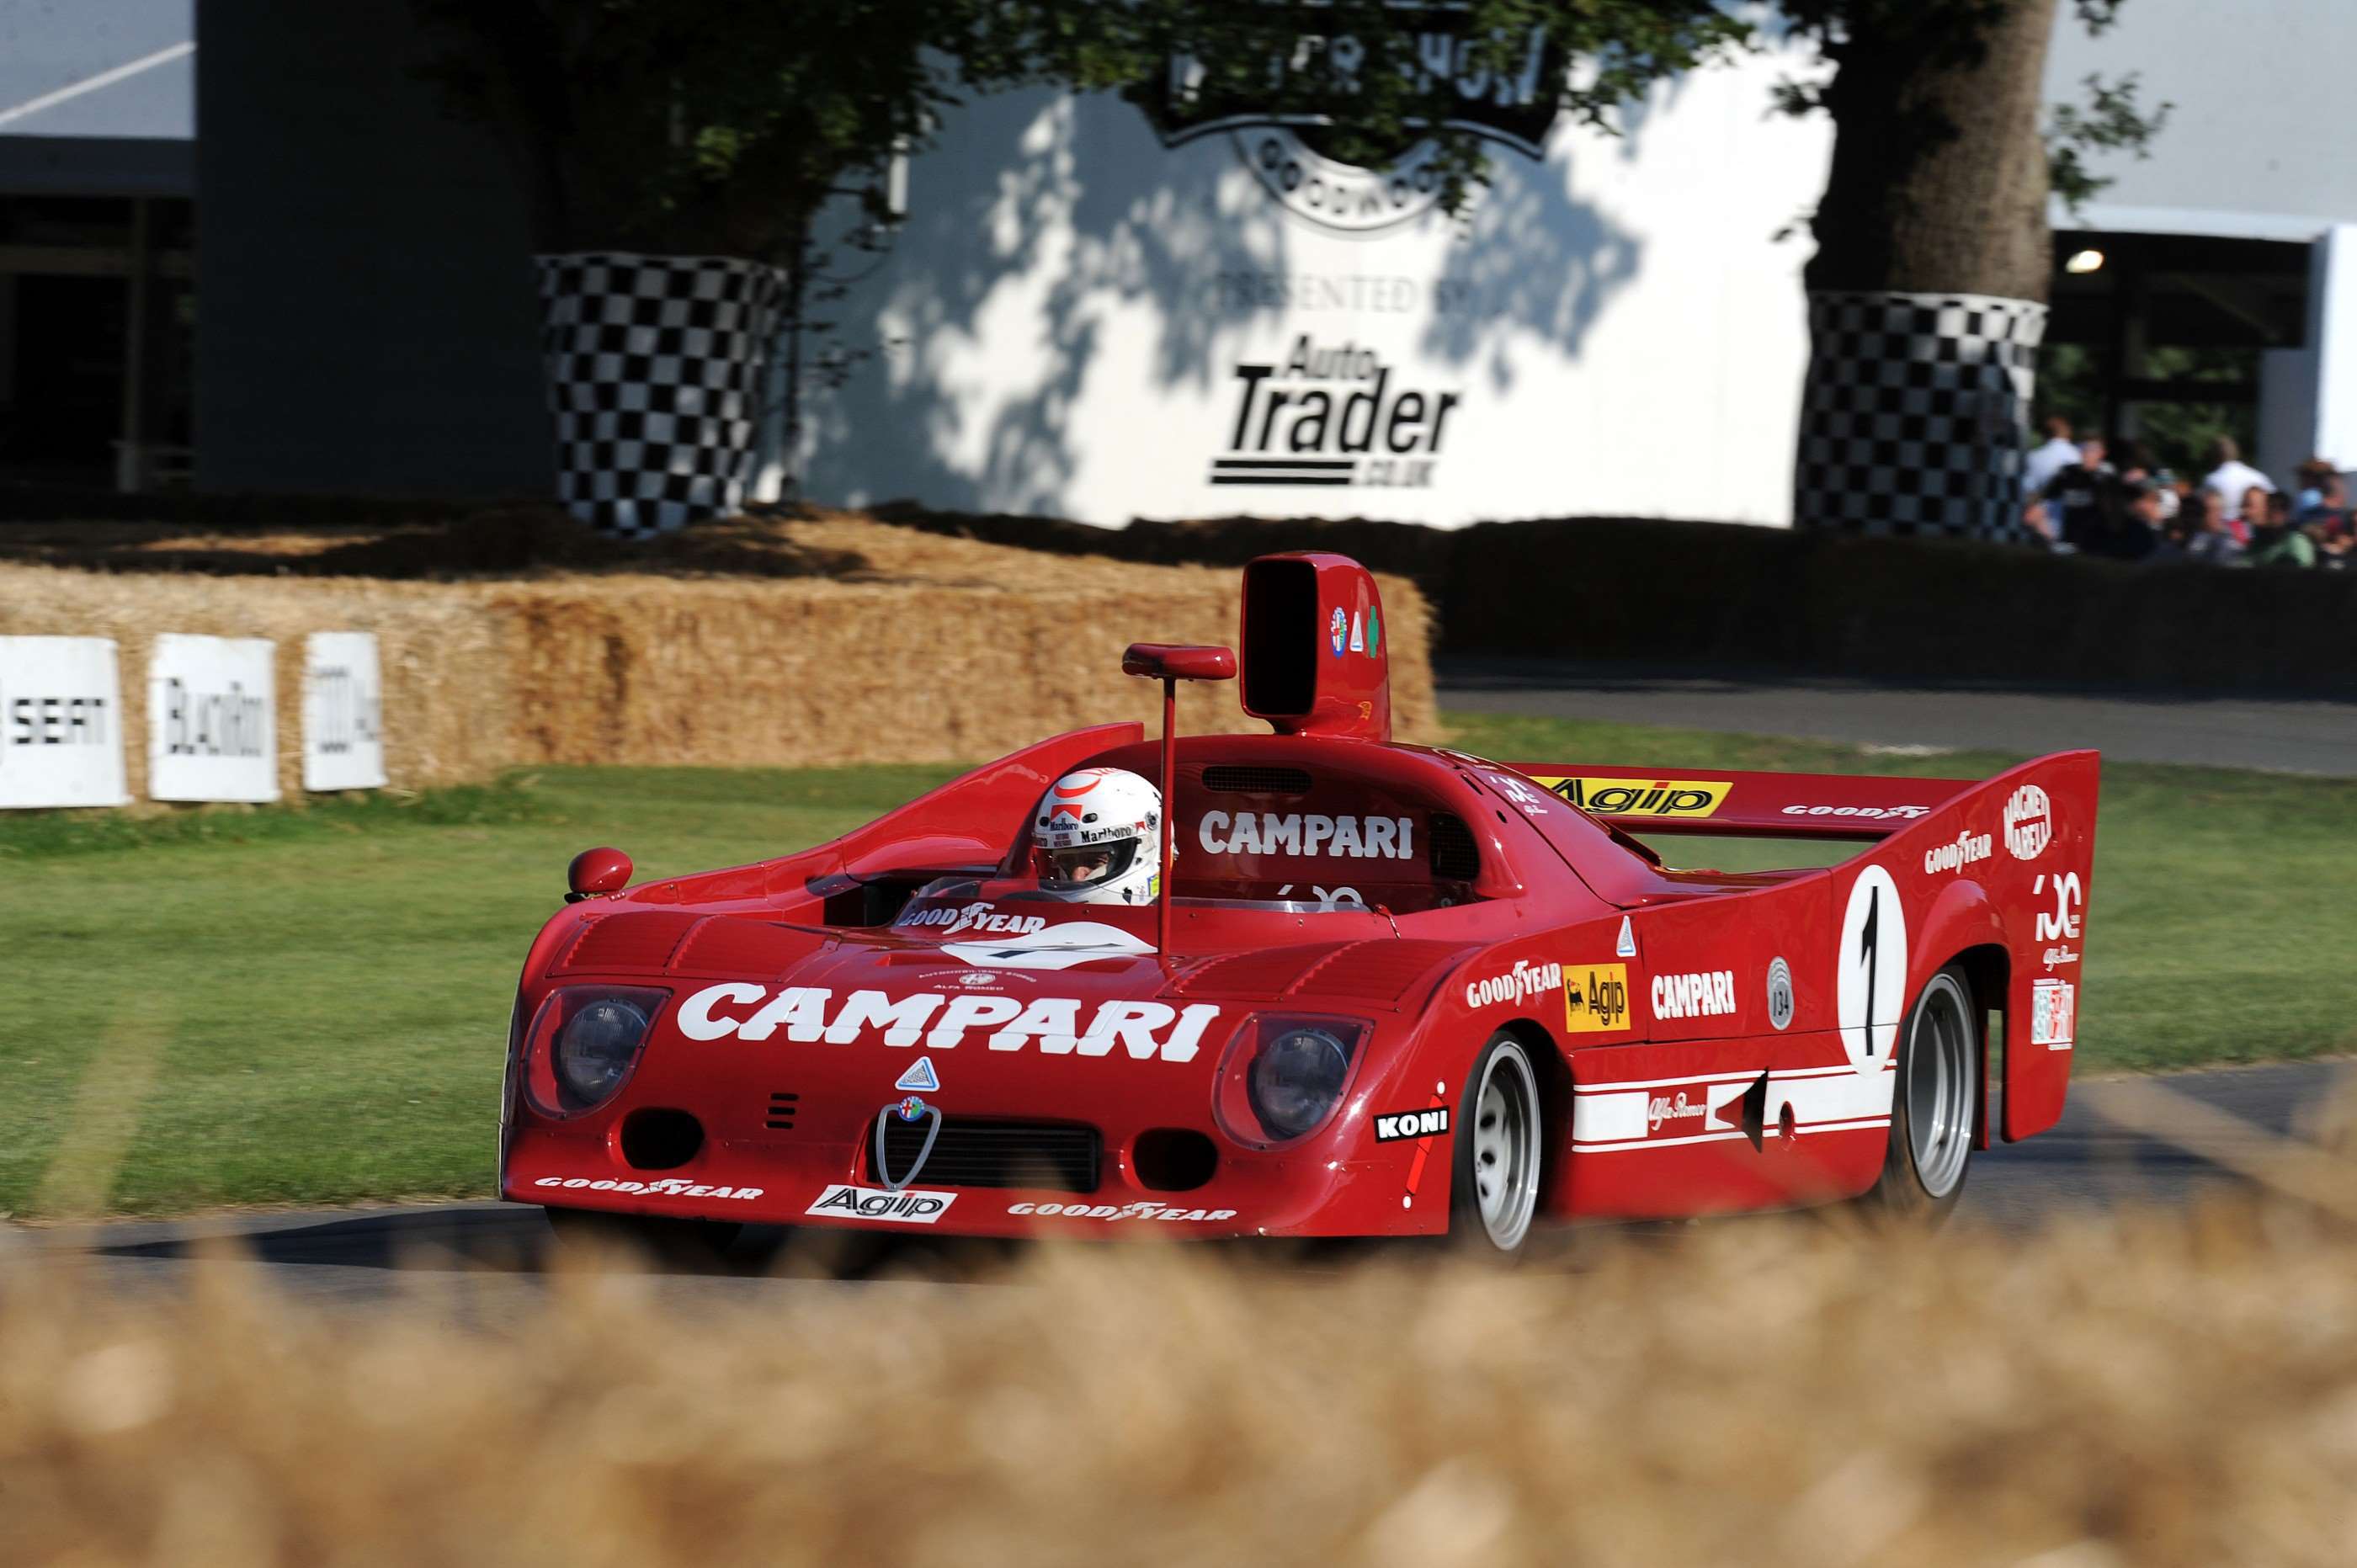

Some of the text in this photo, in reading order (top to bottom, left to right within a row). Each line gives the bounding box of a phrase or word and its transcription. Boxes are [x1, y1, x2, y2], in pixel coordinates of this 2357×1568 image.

[1288, 334, 1379, 380] Auto
[1230, 364, 1462, 454] Trader
[1551, 779, 1713, 814] Agip
[1051, 817, 1079, 832] Marlboro
[1081, 827, 1132, 843] Marlboro
[1200, 811, 1413, 859] CAMPARI
[1924, 830, 1993, 874] GOODYEAR
[901, 901, 1046, 935] GOODYEAR
[1467, 960, 1562, 1008] GOODYEAR
[1860, 885, 1879, 1057] 1
[1588, 970, 1625, 1026] Agip
[1651, 970, 1737, 1020] CAMPARI
[677, 982, 1221, 1064] CAMPARI
[1377, 1109, 1448, 1139] KONI
[535, 1177, 764, 1200] GOODYEAR
[815, 1188, 944, 1218] Agip
[1007, 1201, 1237, 1221] GOODYEAR
